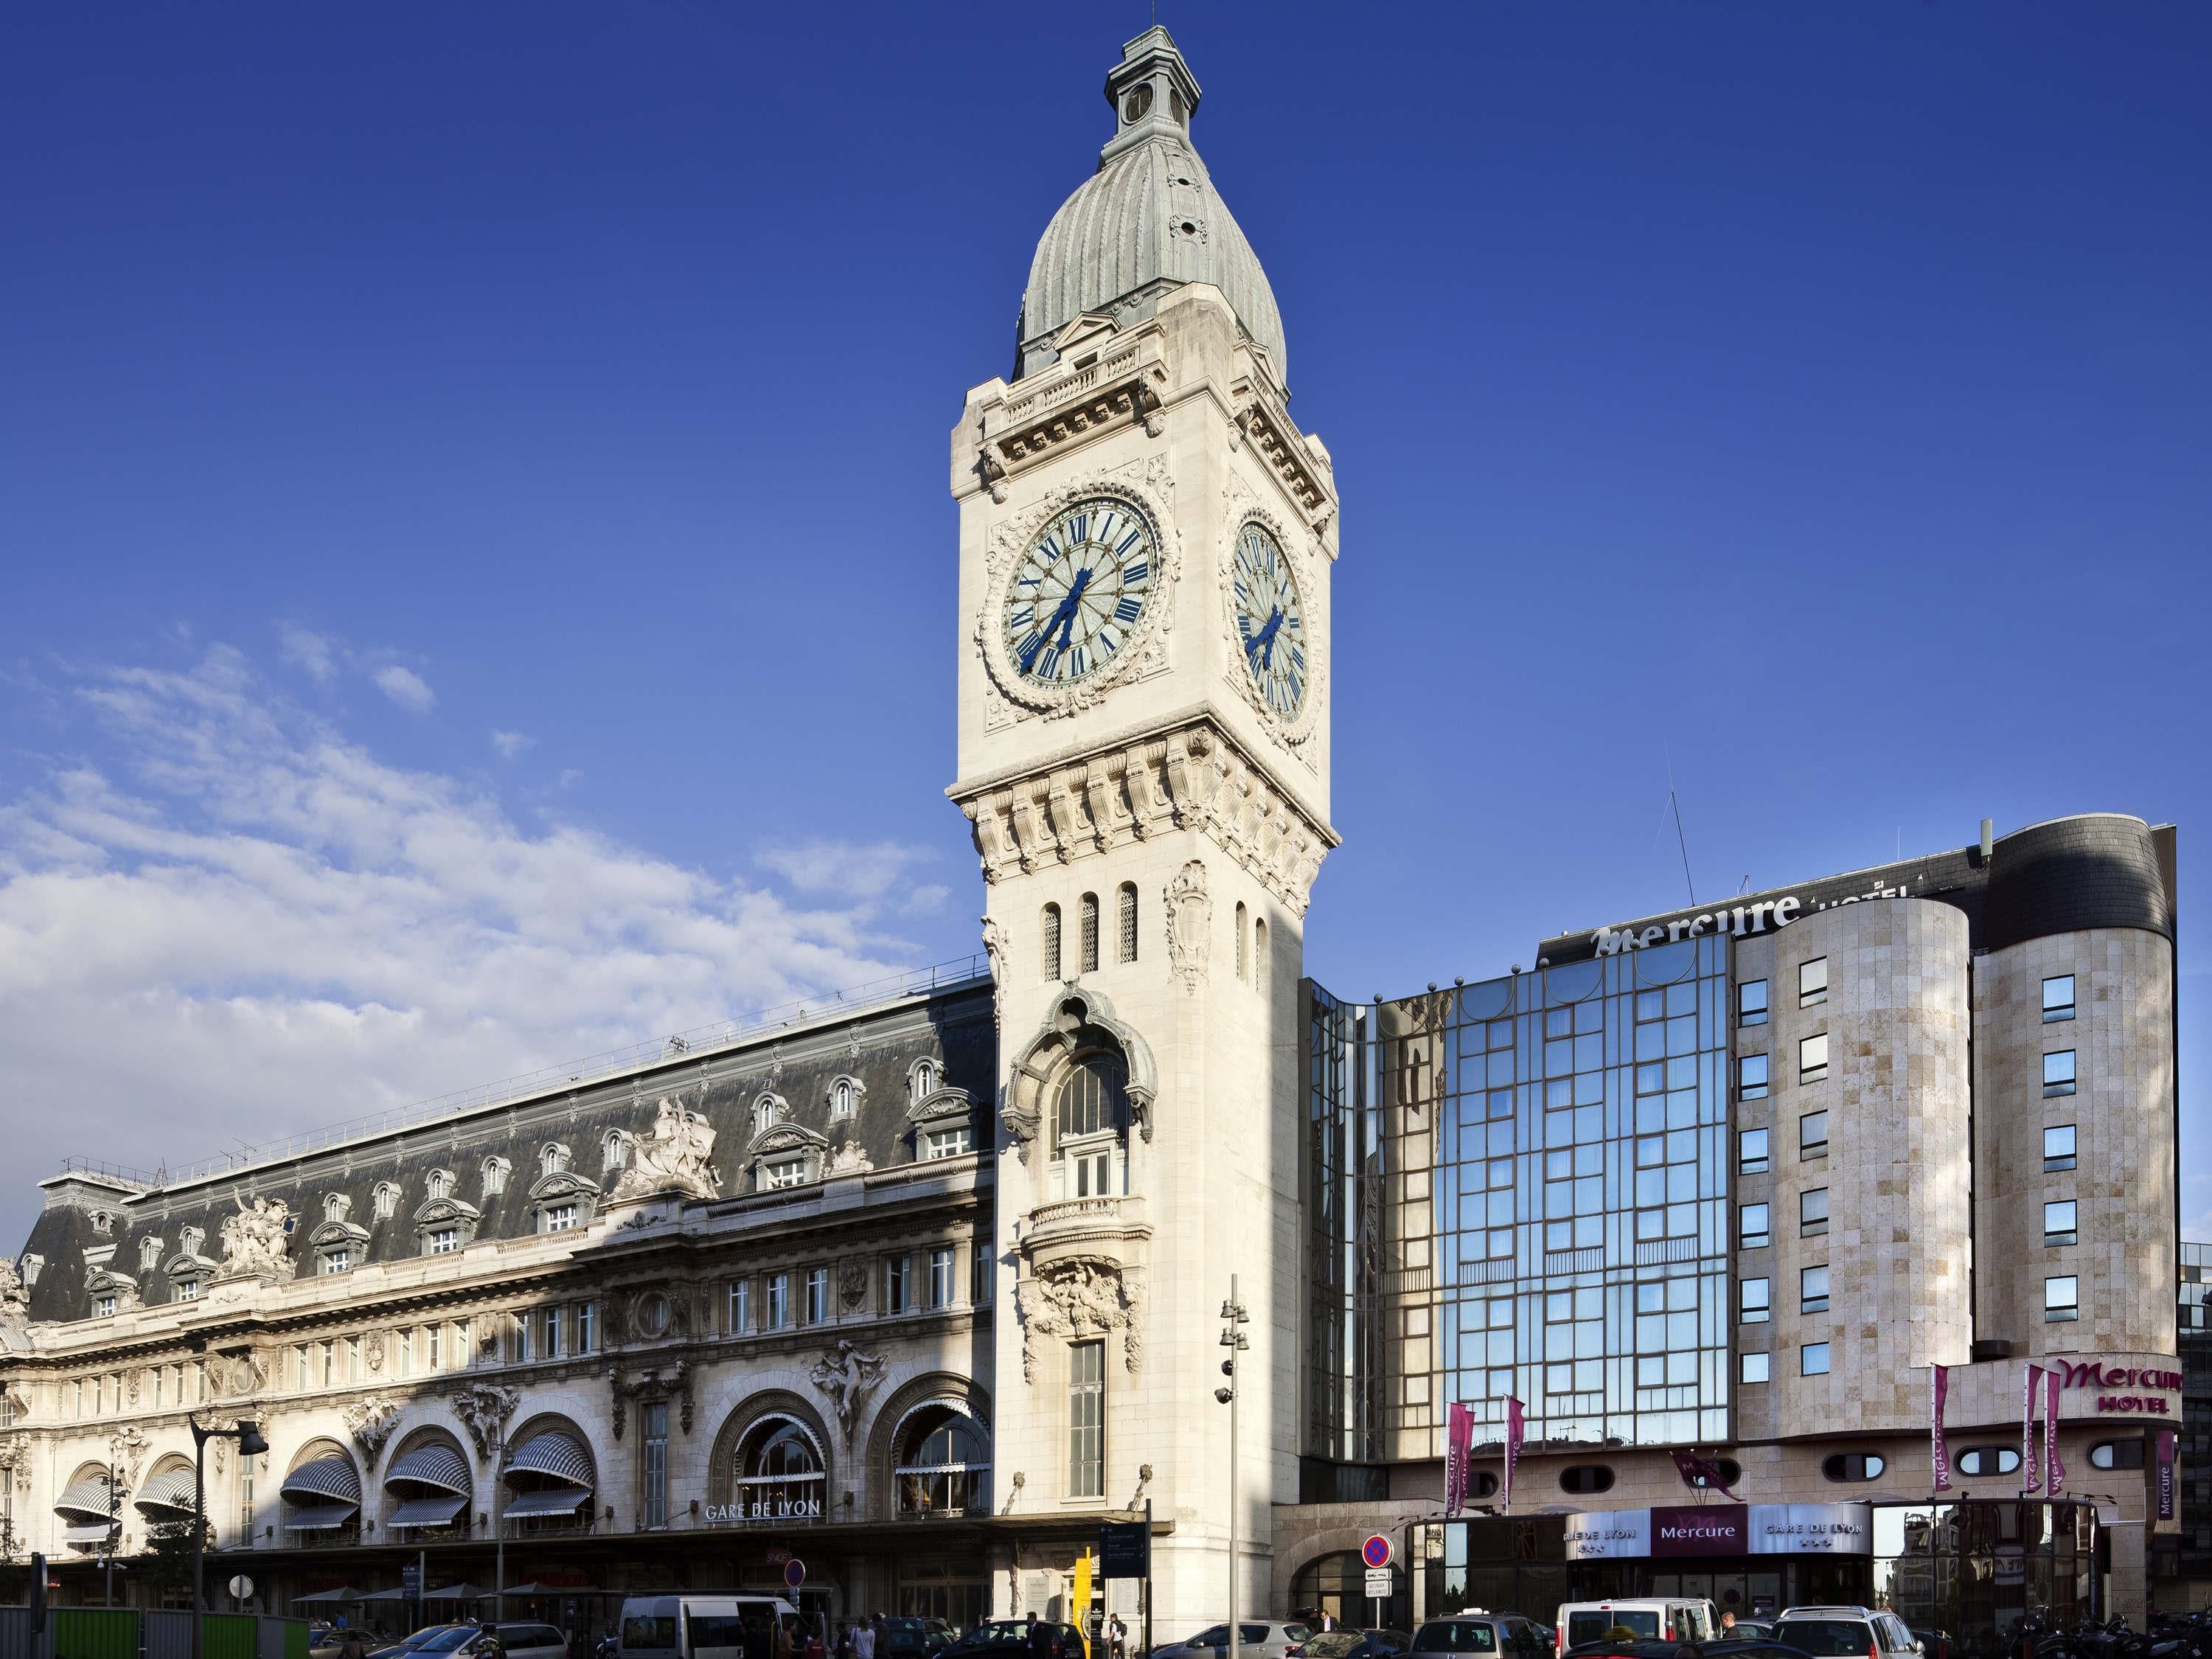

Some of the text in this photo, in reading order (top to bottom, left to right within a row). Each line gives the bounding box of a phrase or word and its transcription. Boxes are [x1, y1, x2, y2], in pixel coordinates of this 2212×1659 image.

[2098, 1395, 2170, 1414] HOTEL
[2160, 1467, 2171, 1514] Mercure
[706, 1499, 820, 1520] GARE DE LYON
[1604, 1528, 1637, 1540] LYON
[1661, 1526, 1736, 1539] Mercure
[1765, 1523, 1863, 1534] GARE DE LYON
